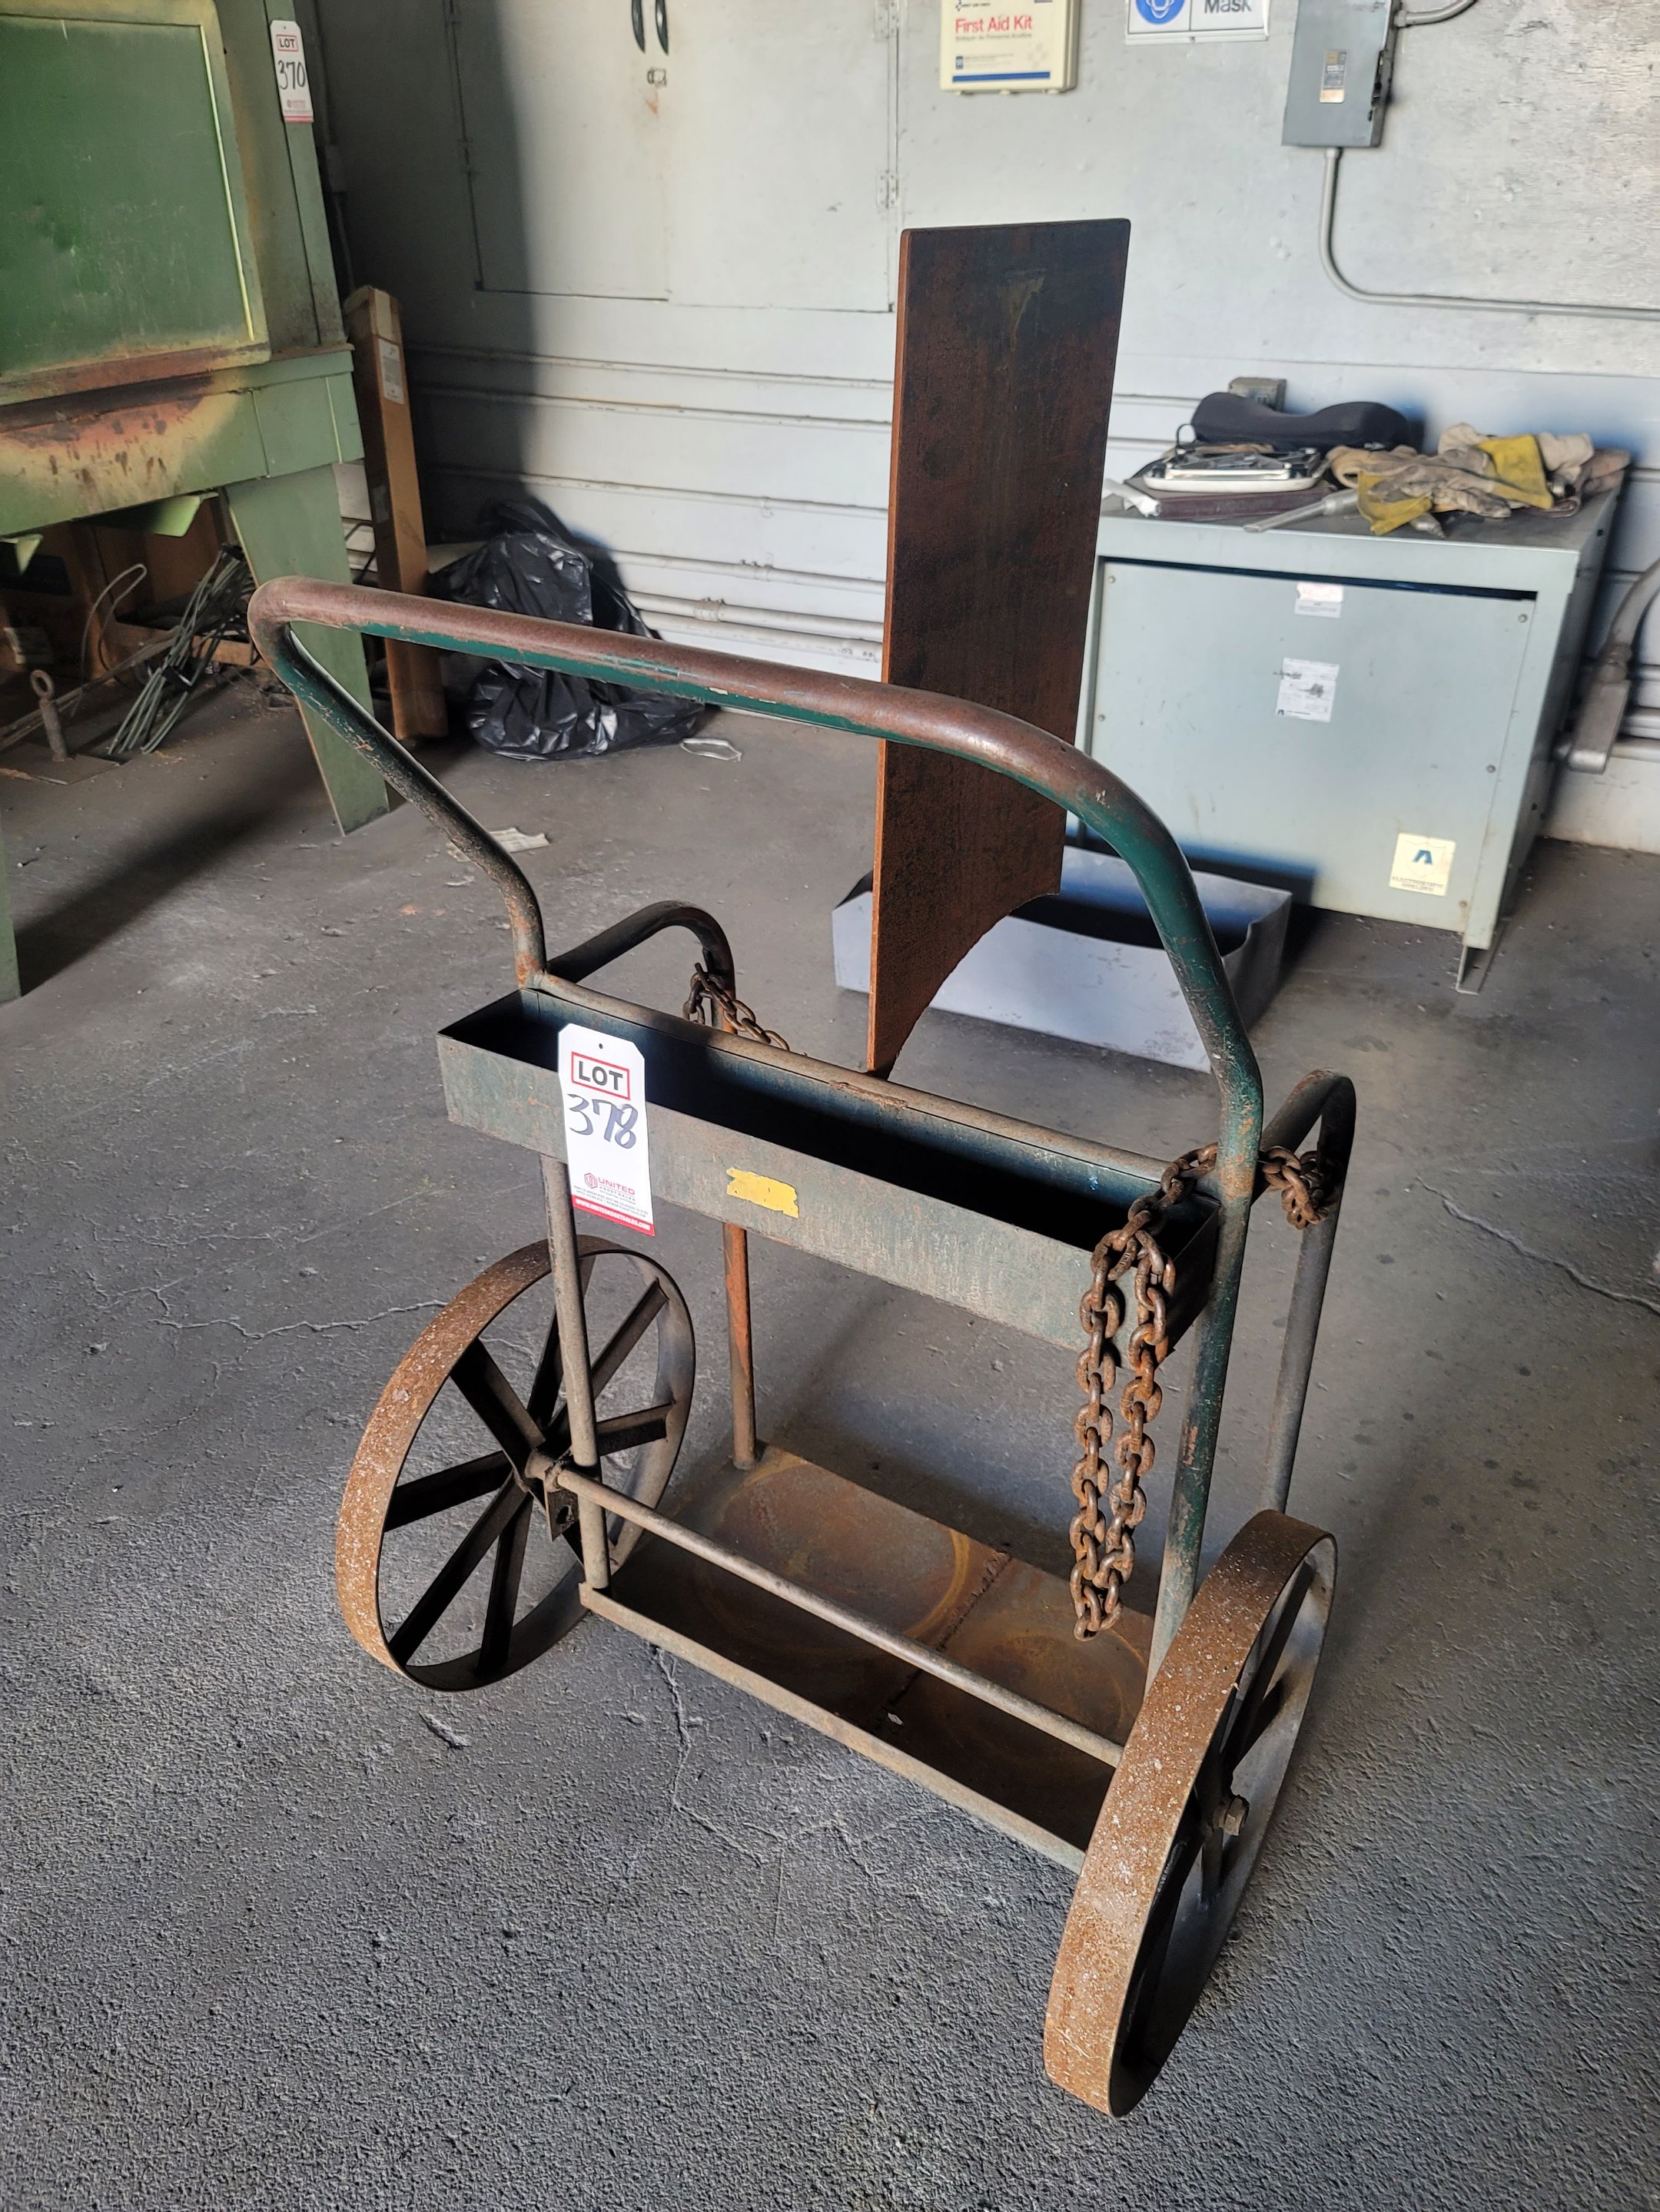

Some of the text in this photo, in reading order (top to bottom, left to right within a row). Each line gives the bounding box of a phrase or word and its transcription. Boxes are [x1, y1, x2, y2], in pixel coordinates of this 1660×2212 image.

[1204, 0, 1252, 13] Mask
[955, 15, 1033, 33] First Aid Kit
[279, 38, 295, 48] LOT
[278, 60, 306, 90] 370
[579, 1060, 624, 1091] LOT
[567, 1093, 639, 1149] 378
[598, 1176, 636, 1196] UNITED
